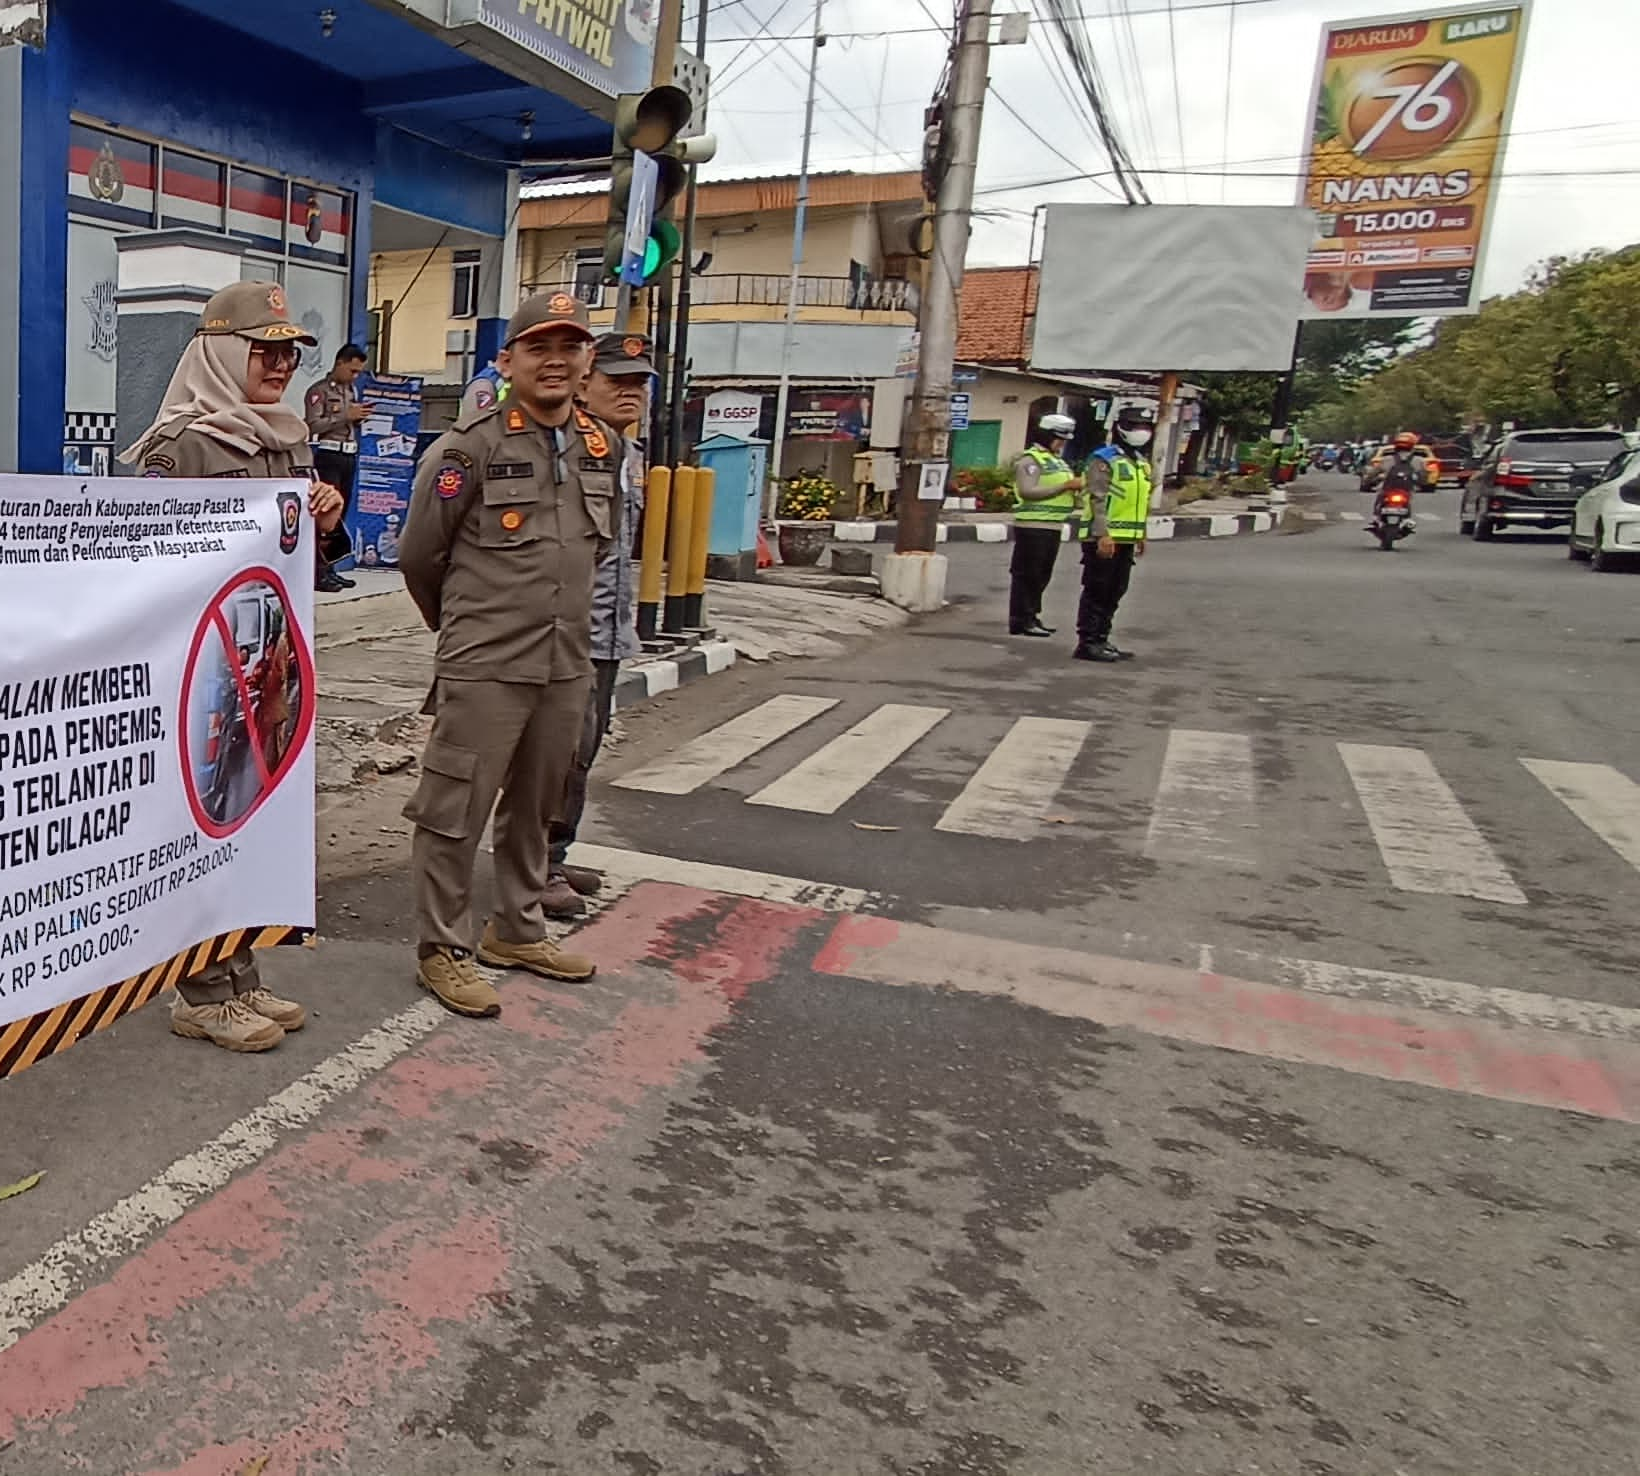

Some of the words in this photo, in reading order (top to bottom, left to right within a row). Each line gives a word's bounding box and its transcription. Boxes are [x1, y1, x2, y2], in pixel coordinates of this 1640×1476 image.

[1334, 27, 1415, 49] DJARUM
[1447, 16, 1507, 40] BARU
[1353, 60, 1459, 156] 76
[1324, 170, 1469, 203] NANAS
[724, 407, 758, 418] GGSP
[11, 522, 67, 545] tentang
[69, 521, 173, 543] Penyelenggaraan
[175, 518, 262, 536] Ketenteraman,
[43, 498, 92, 518] Daerah
[95, 499, 160, 520] Kabupaten
[162, 498, 201, 519] Cilacap
[203, 498, 231, 515] Pasal
[232, 498, 246, 514] 23
[44, 544, 69, 562] dan
[72, 542, 153, 562] Pelindungan
[156, 538, 226, 558] Masyarakat
[60, 662, 151, 711] MEMBERI
[65, 705, 166, 757] PENGEMIS,
[13, 756, 133, 818] TERLANTAR
[139, 750, 156, 785] DI
[46, 801, 131, 857] CILACAP
[0, 855, 144, 923] ADMINISTRATIF
[149, 831, 198, 873] BERUPA
[35, 898, 101, 946] PALING
[107, 872, 165, 918] SEDIKIT
[168, 866, 185, 892] RP
[187, 839, 240, 883] 250.000,-
[11, 960, 37, 992] RP
[41, 924, 140, 978] 5.000.000,-
